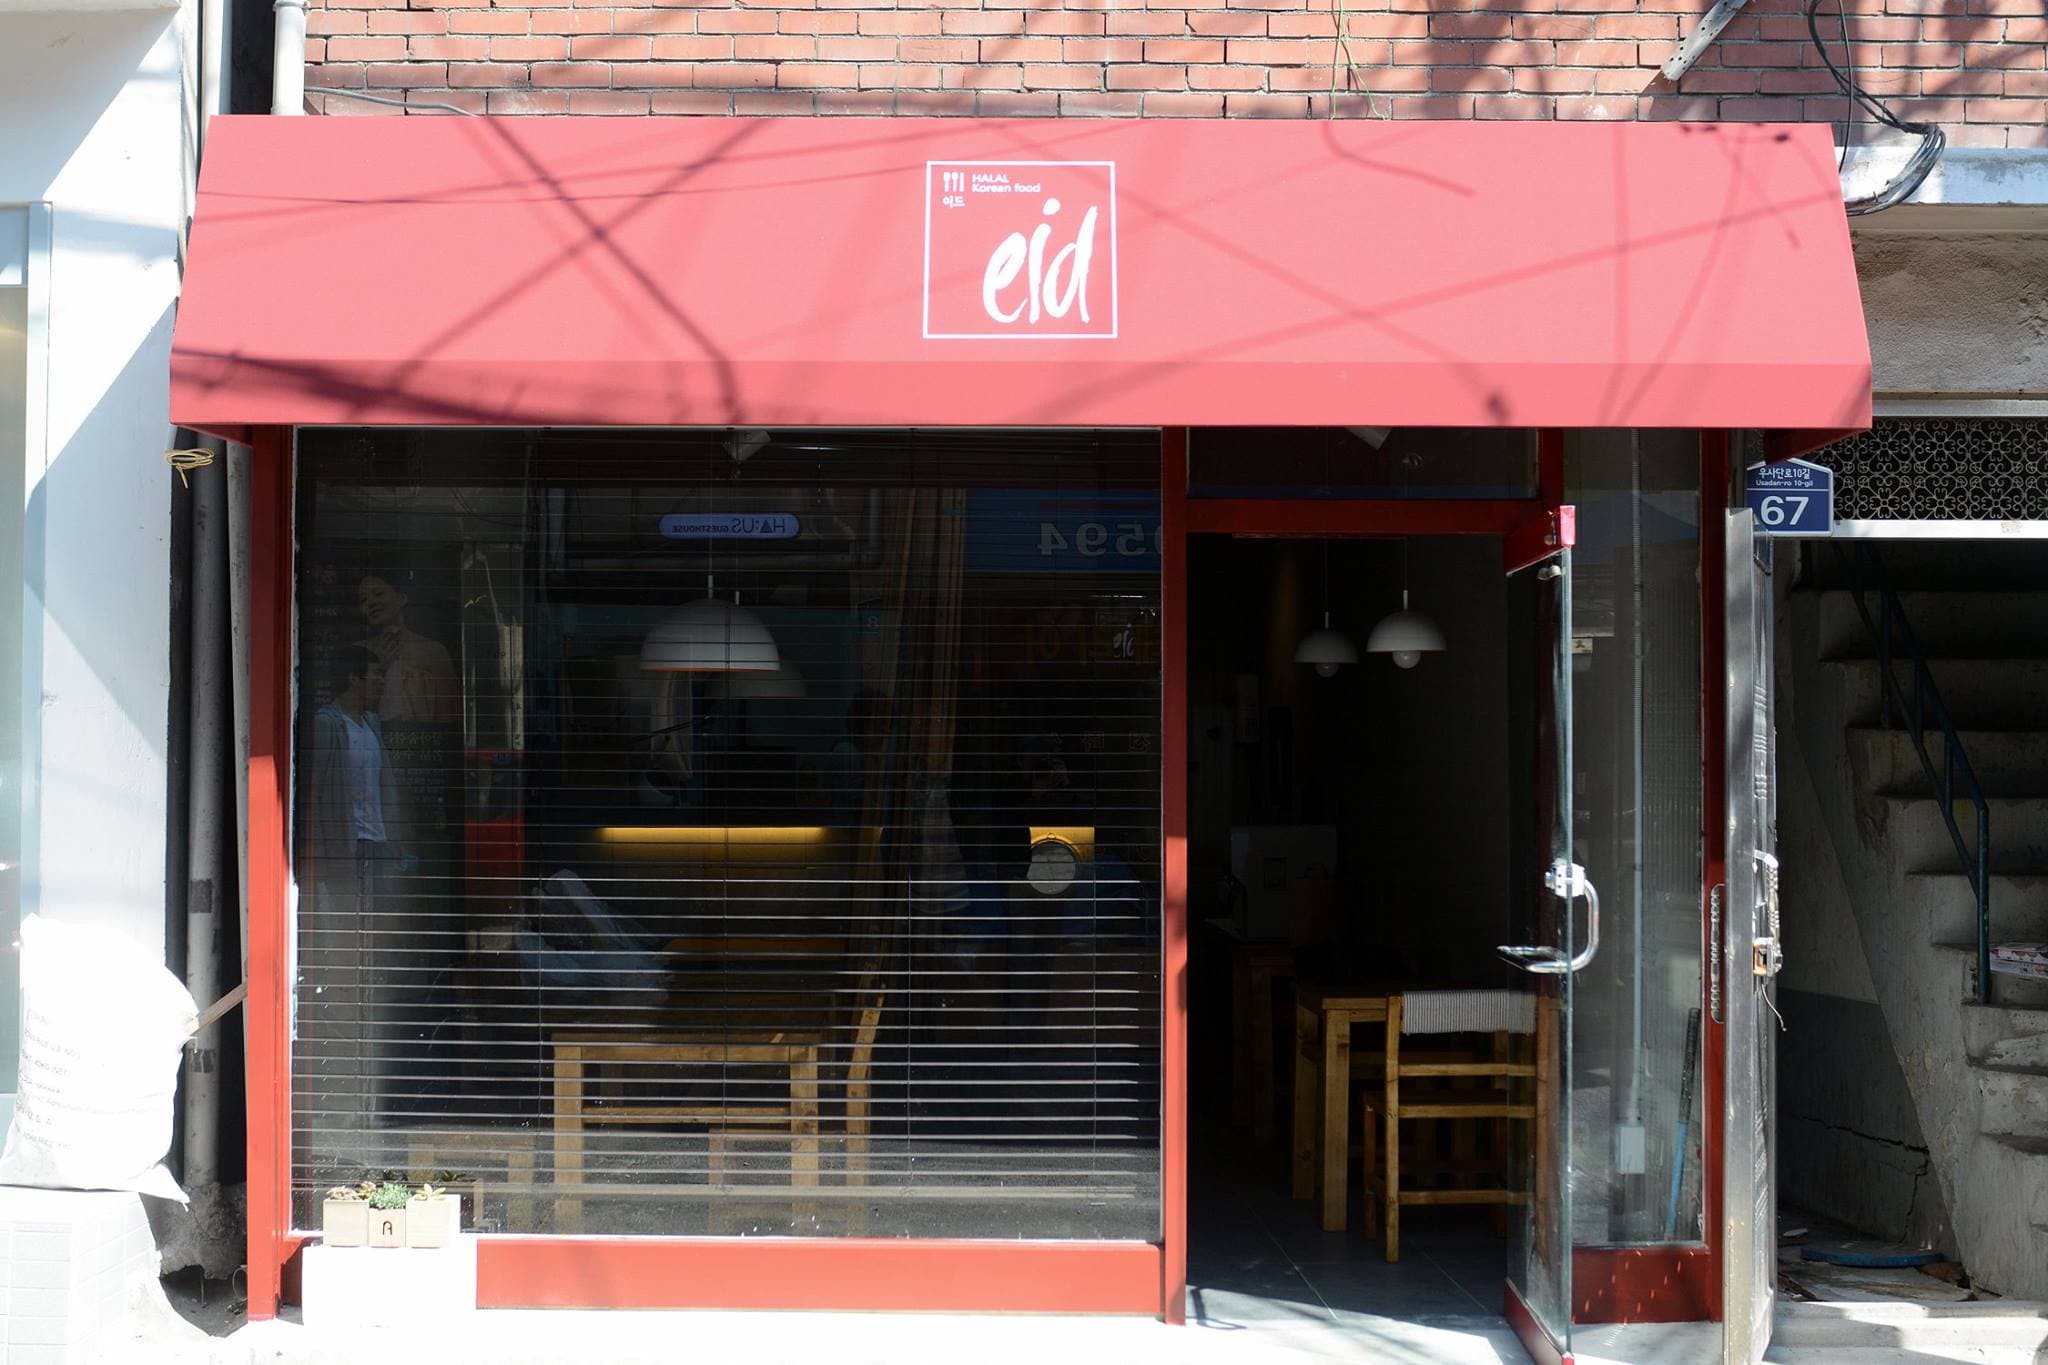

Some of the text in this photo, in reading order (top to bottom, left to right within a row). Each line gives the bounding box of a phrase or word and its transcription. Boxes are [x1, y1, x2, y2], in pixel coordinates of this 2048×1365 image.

[971, 174, 1010, 183] HALAL
[971, 183, 1041, 193] Korean food
[983, 197, 1098, 324] eid
[1758, 467, 1811, 480] 우사단로10길
[1794, 480, 1814, 488] 10-gil
[1760, 495, 1809, 525] 67
